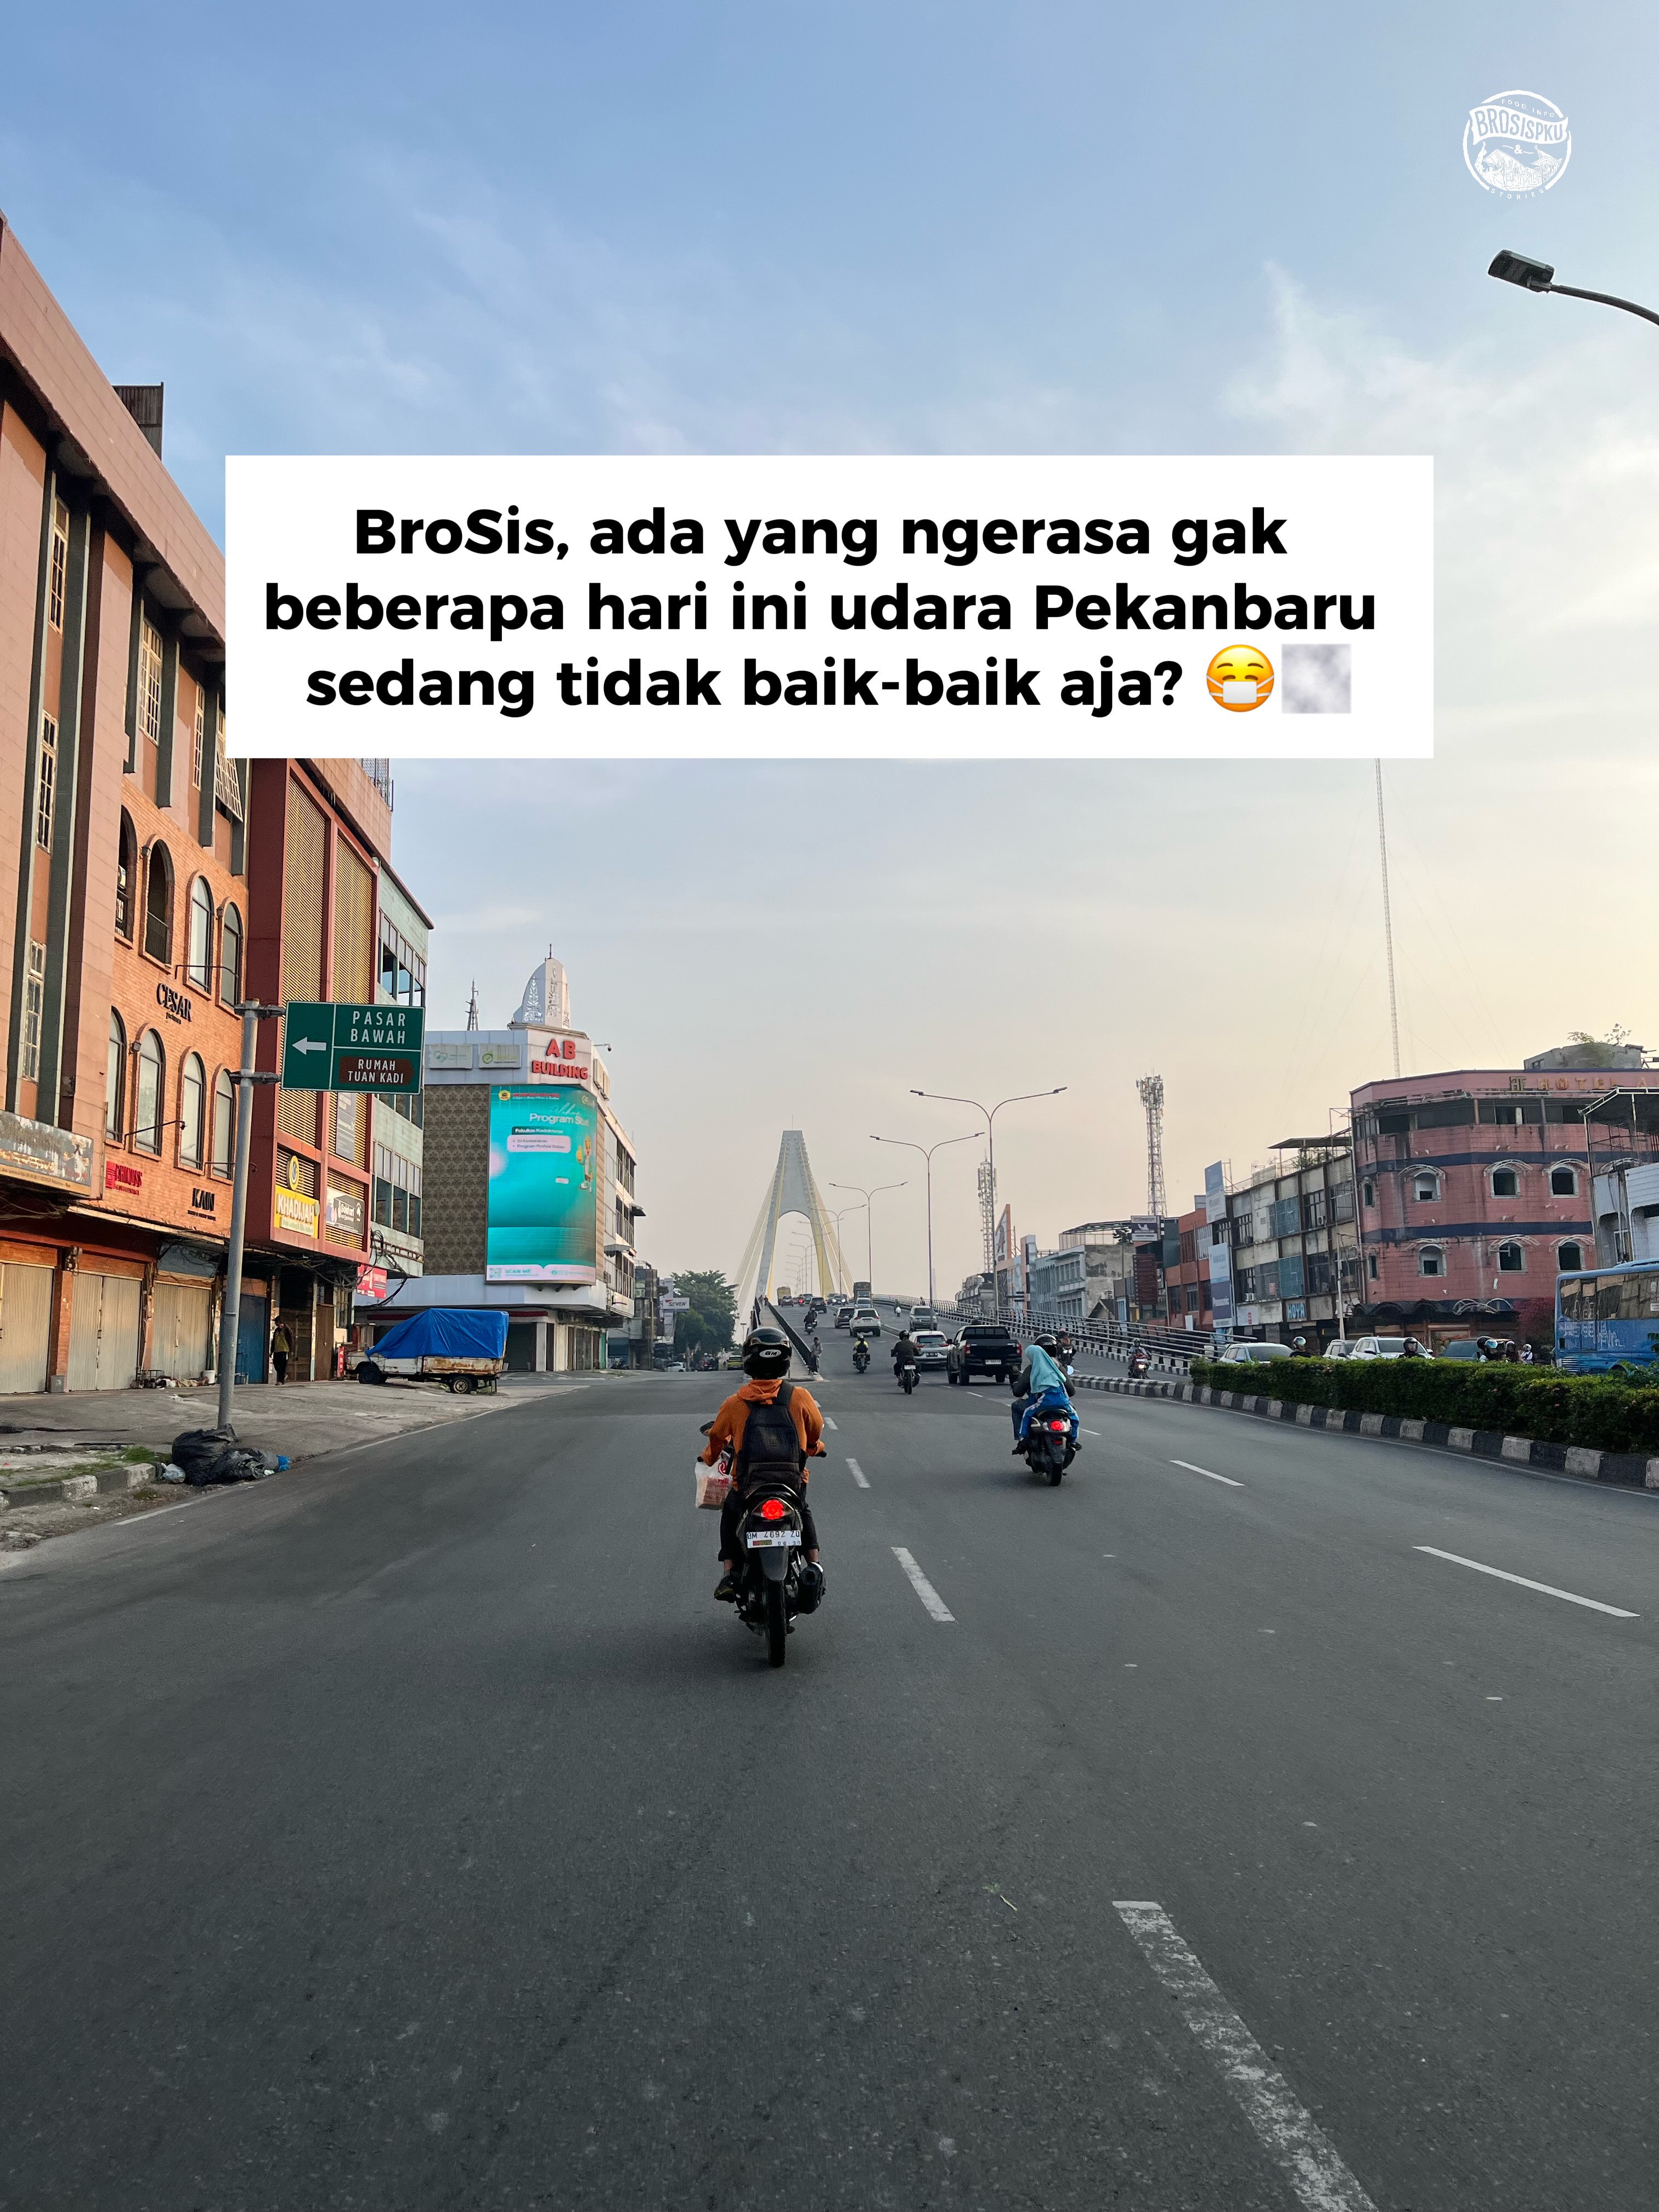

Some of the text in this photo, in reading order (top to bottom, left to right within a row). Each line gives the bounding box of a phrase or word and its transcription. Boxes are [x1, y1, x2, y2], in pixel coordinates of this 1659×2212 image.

[156, 983, 191, 1022] CESAR
[353, 1011, 405, 1026] PASAR
[351, 1028, 405, 1044] BAWAH
[358, 1059, 396, 1071] RUMAH
[532, 1060, 588, 1079] BUILDING
[348, 1071, 403, 1084] TUAN KADI
[529, 1113, 574, 1125] Program
[276, 1193, 314, 1224] KHADIJAH
[1288, 1303, 1305, 1319] HOYA
